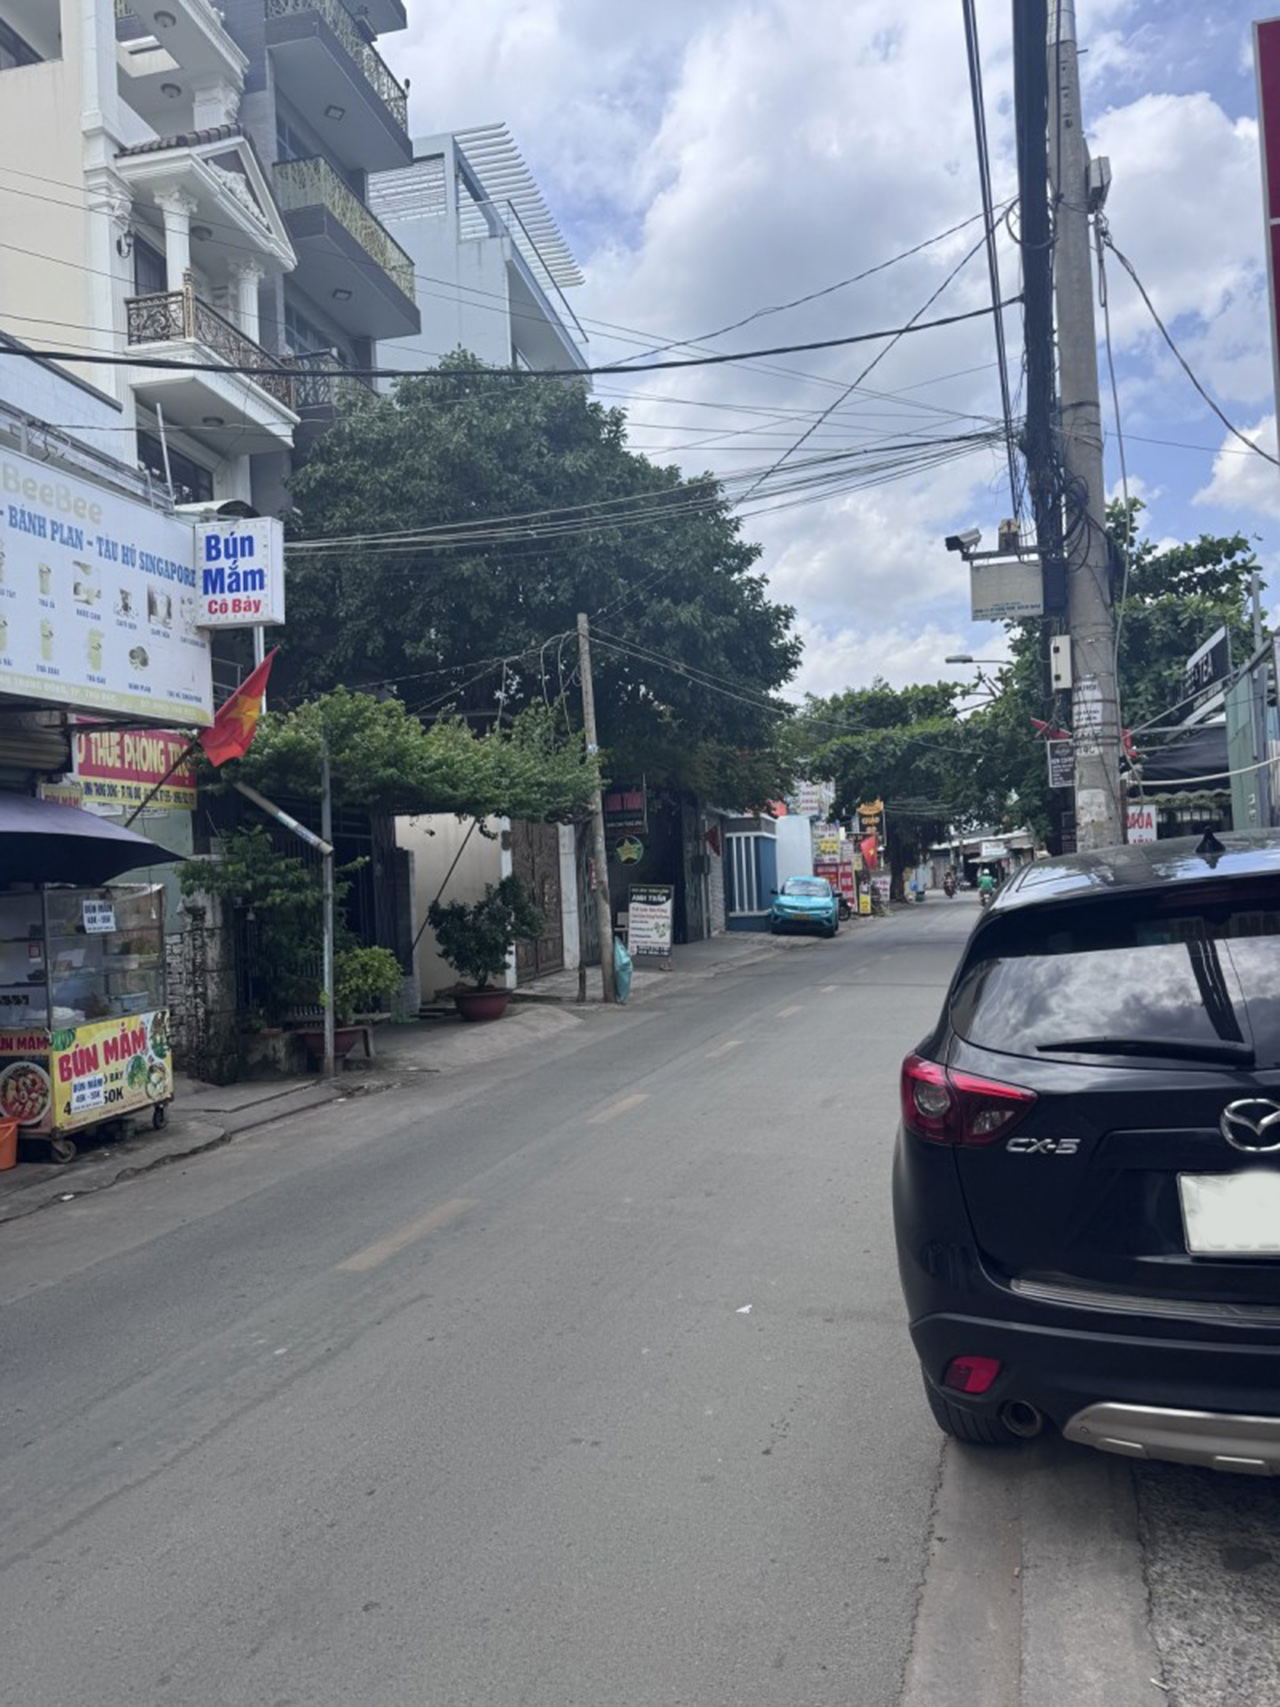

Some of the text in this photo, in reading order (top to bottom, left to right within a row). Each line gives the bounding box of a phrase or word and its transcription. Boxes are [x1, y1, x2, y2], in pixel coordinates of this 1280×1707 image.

[2, 461, 103, 525] BeeBee
[8, 503, 47, 539] BÁNH
[50, 519, 84, 551] PLAN
[139, 551, 196, 588] SINGAPORE
[205, 531, 254, 562] Bún
[203, 560, 265, 596] Mắm
[208, 598, 228, 614] Cô
[58, 1021, 147, 1083] BÚN MẮM
[1006, 1138, 1081, 1154] CX-5
